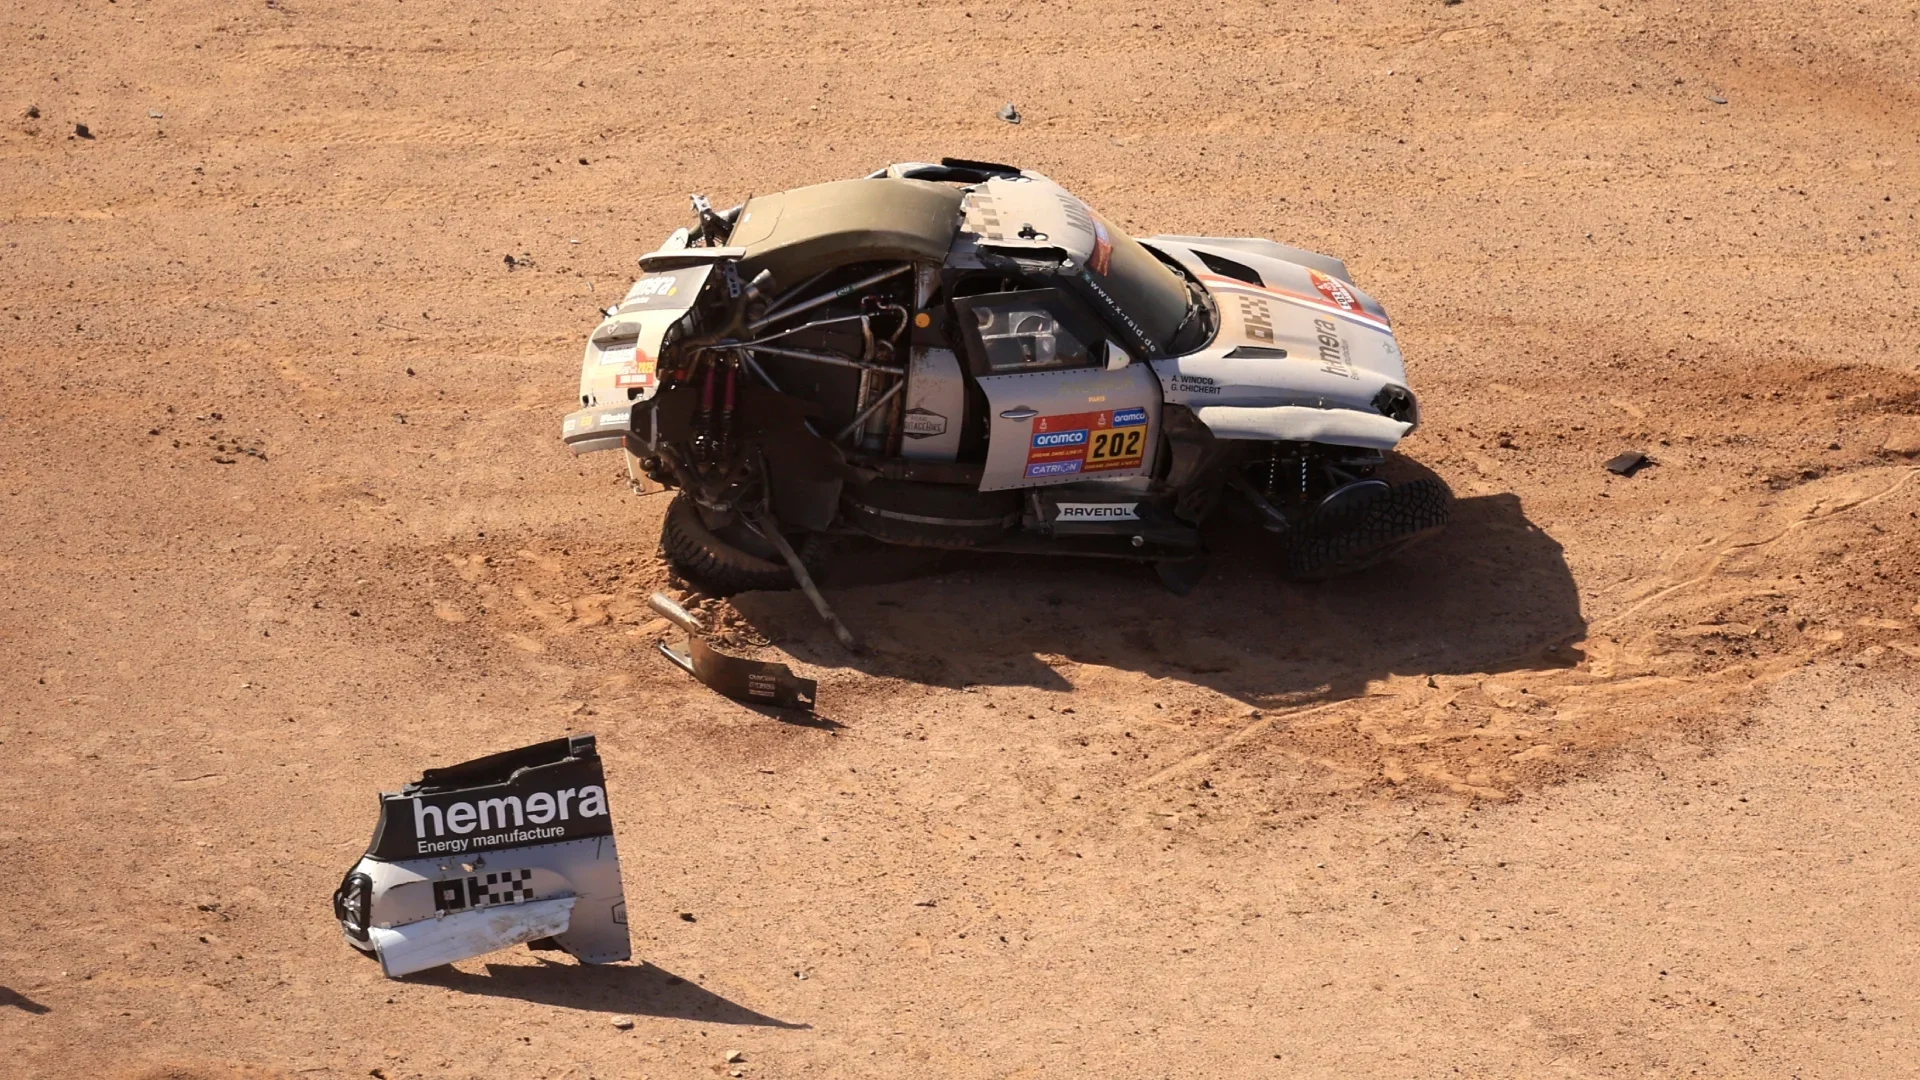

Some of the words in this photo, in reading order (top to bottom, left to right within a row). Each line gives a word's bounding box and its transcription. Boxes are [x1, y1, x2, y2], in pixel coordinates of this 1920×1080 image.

[1090, 281, 1156, 352] www.x-raid.de
[1181, 376, 1214, 385] WINOCQ
[1171, 383, 1179, 391] G.
[1180, 384, 1221, 395] CHICHERIT
[1114, 413, 1145, 422] aramco
[1037, 432, 1083, 445] aramco
[1092, 431, 1140, 459] 202
[1032, 463, 1077, 474] CATRION
[1064, 507, 1131, 517] RAVENOL
[417, 837, 469, 854] Energy
[473, 825, 565, 847] manufacture
